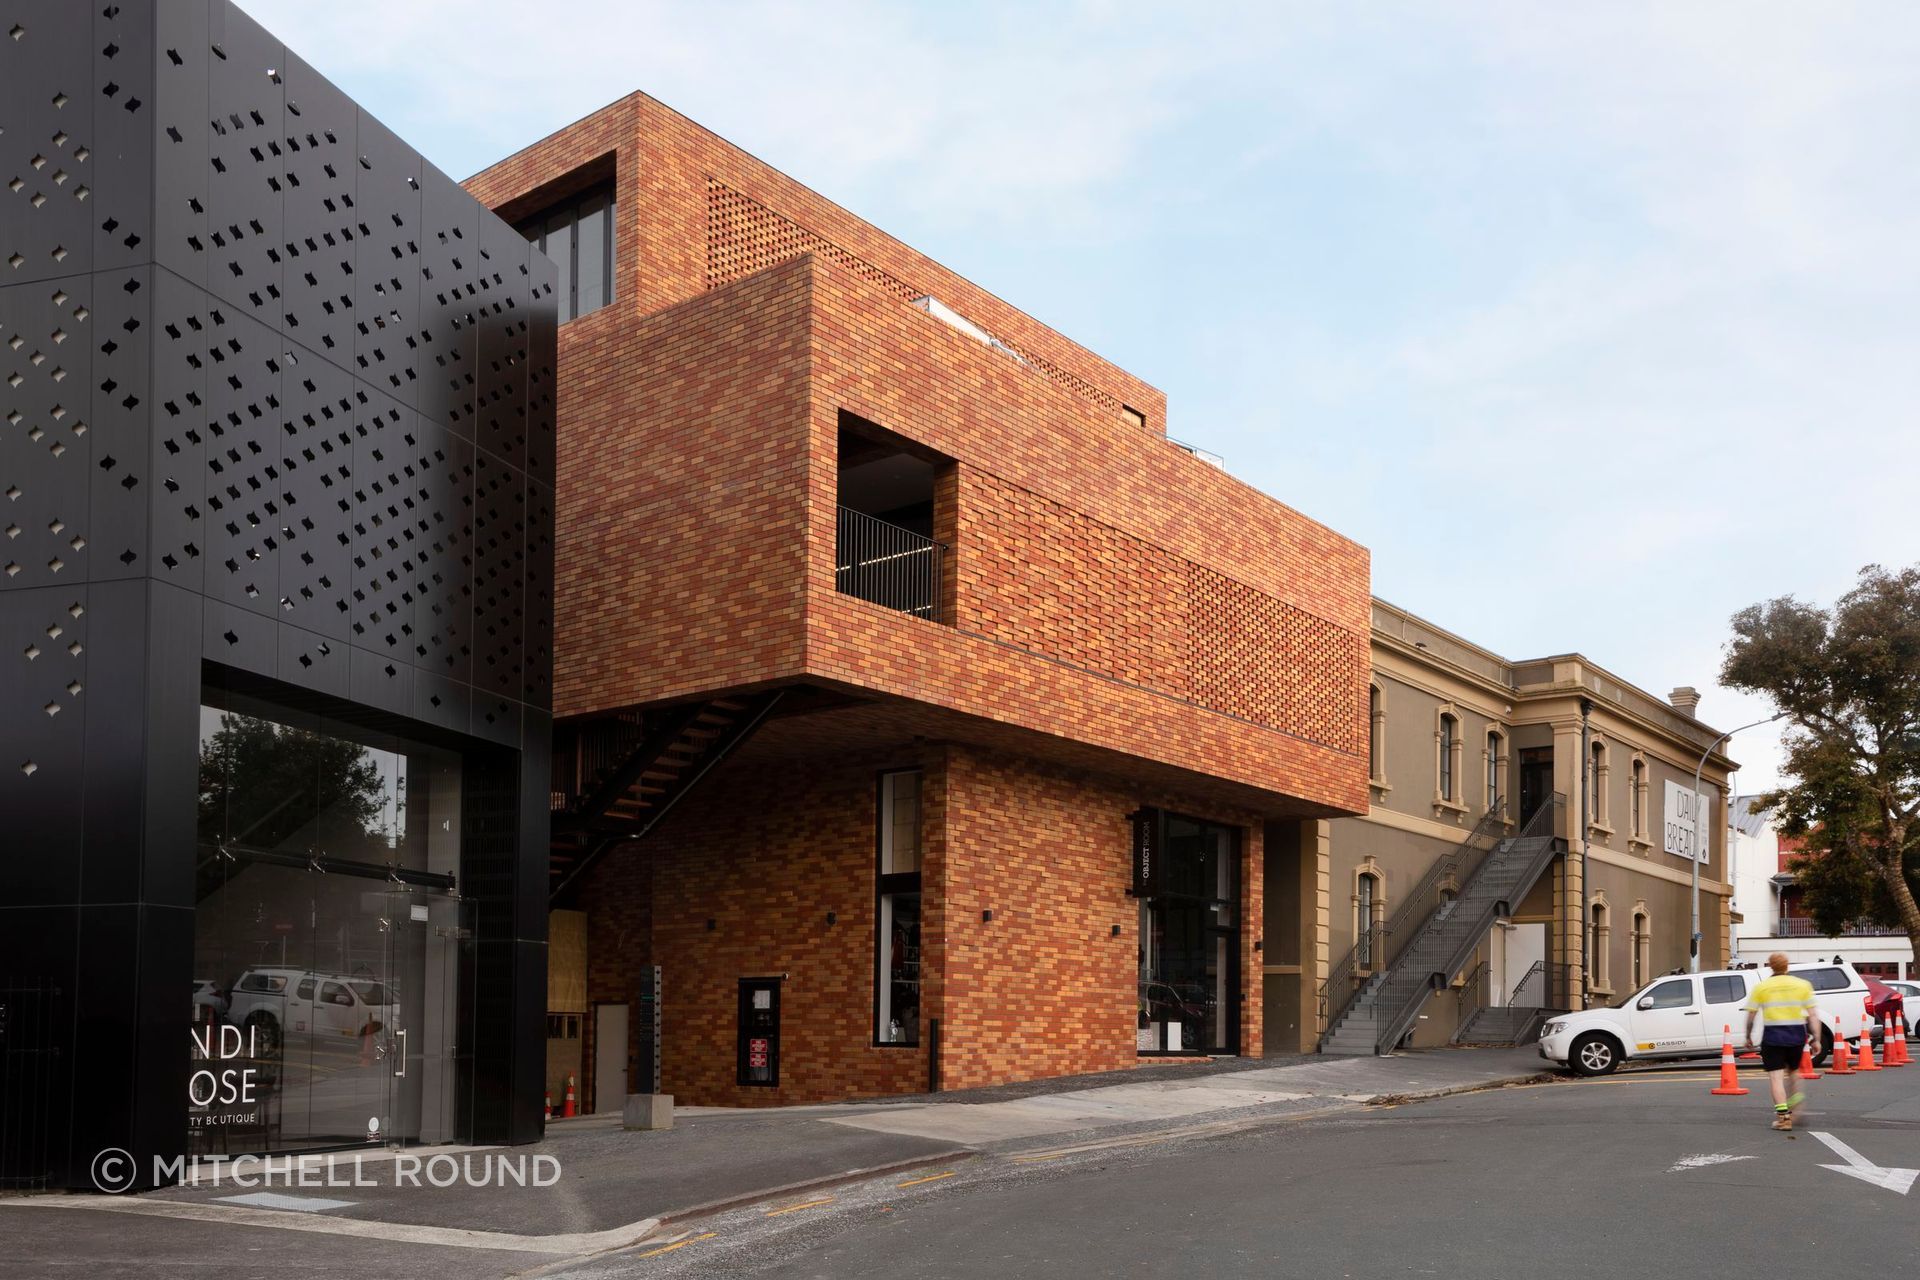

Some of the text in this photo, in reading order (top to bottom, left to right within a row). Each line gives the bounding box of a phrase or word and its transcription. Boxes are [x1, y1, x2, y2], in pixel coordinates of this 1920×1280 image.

[1142, 821, 1150, 846] ROOM
[1667, 822, 1695, 856] BREAD
[1142, 847, 1150, 879] OBJECT
[189, 1069, 256, 1106] OSE
